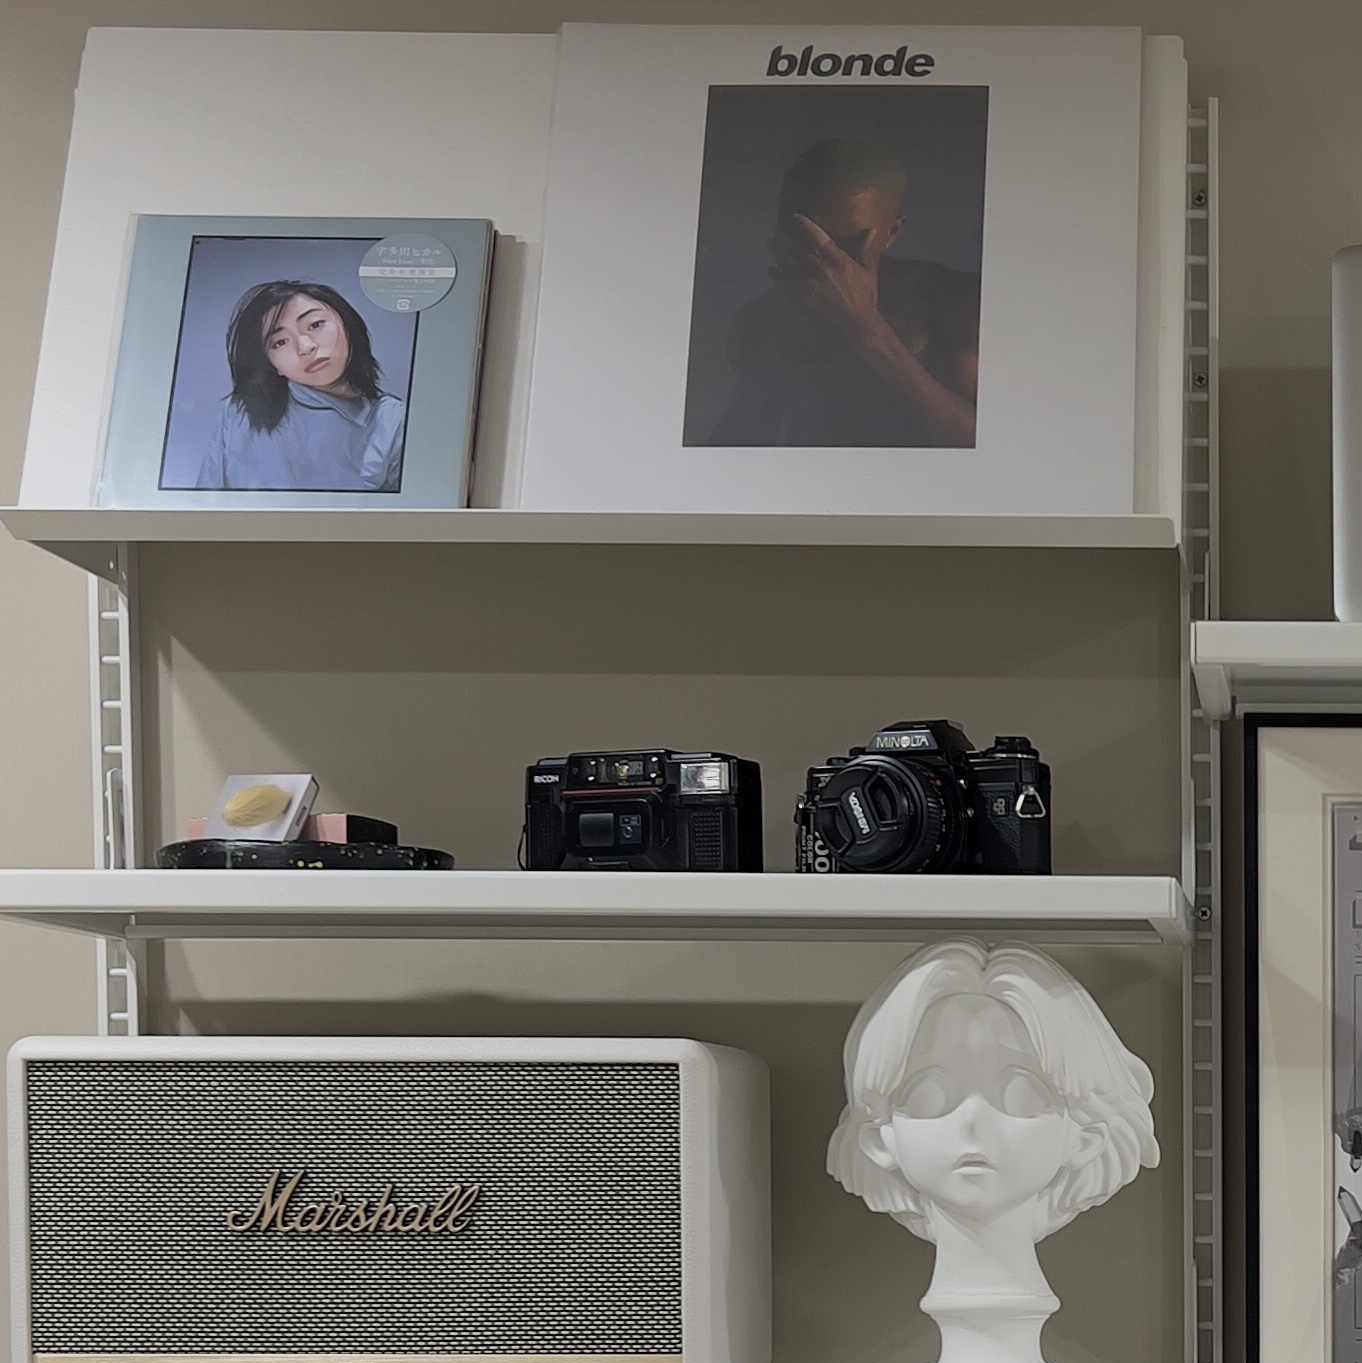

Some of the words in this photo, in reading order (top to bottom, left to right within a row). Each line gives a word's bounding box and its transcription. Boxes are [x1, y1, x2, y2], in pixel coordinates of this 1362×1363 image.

[766, 45, 935, 77] blonde
[876, 735, 929, 748] MINOLTA
[533, 775, 559, 783] RICOH
[227, 1169, 480, 1233] Marshall
